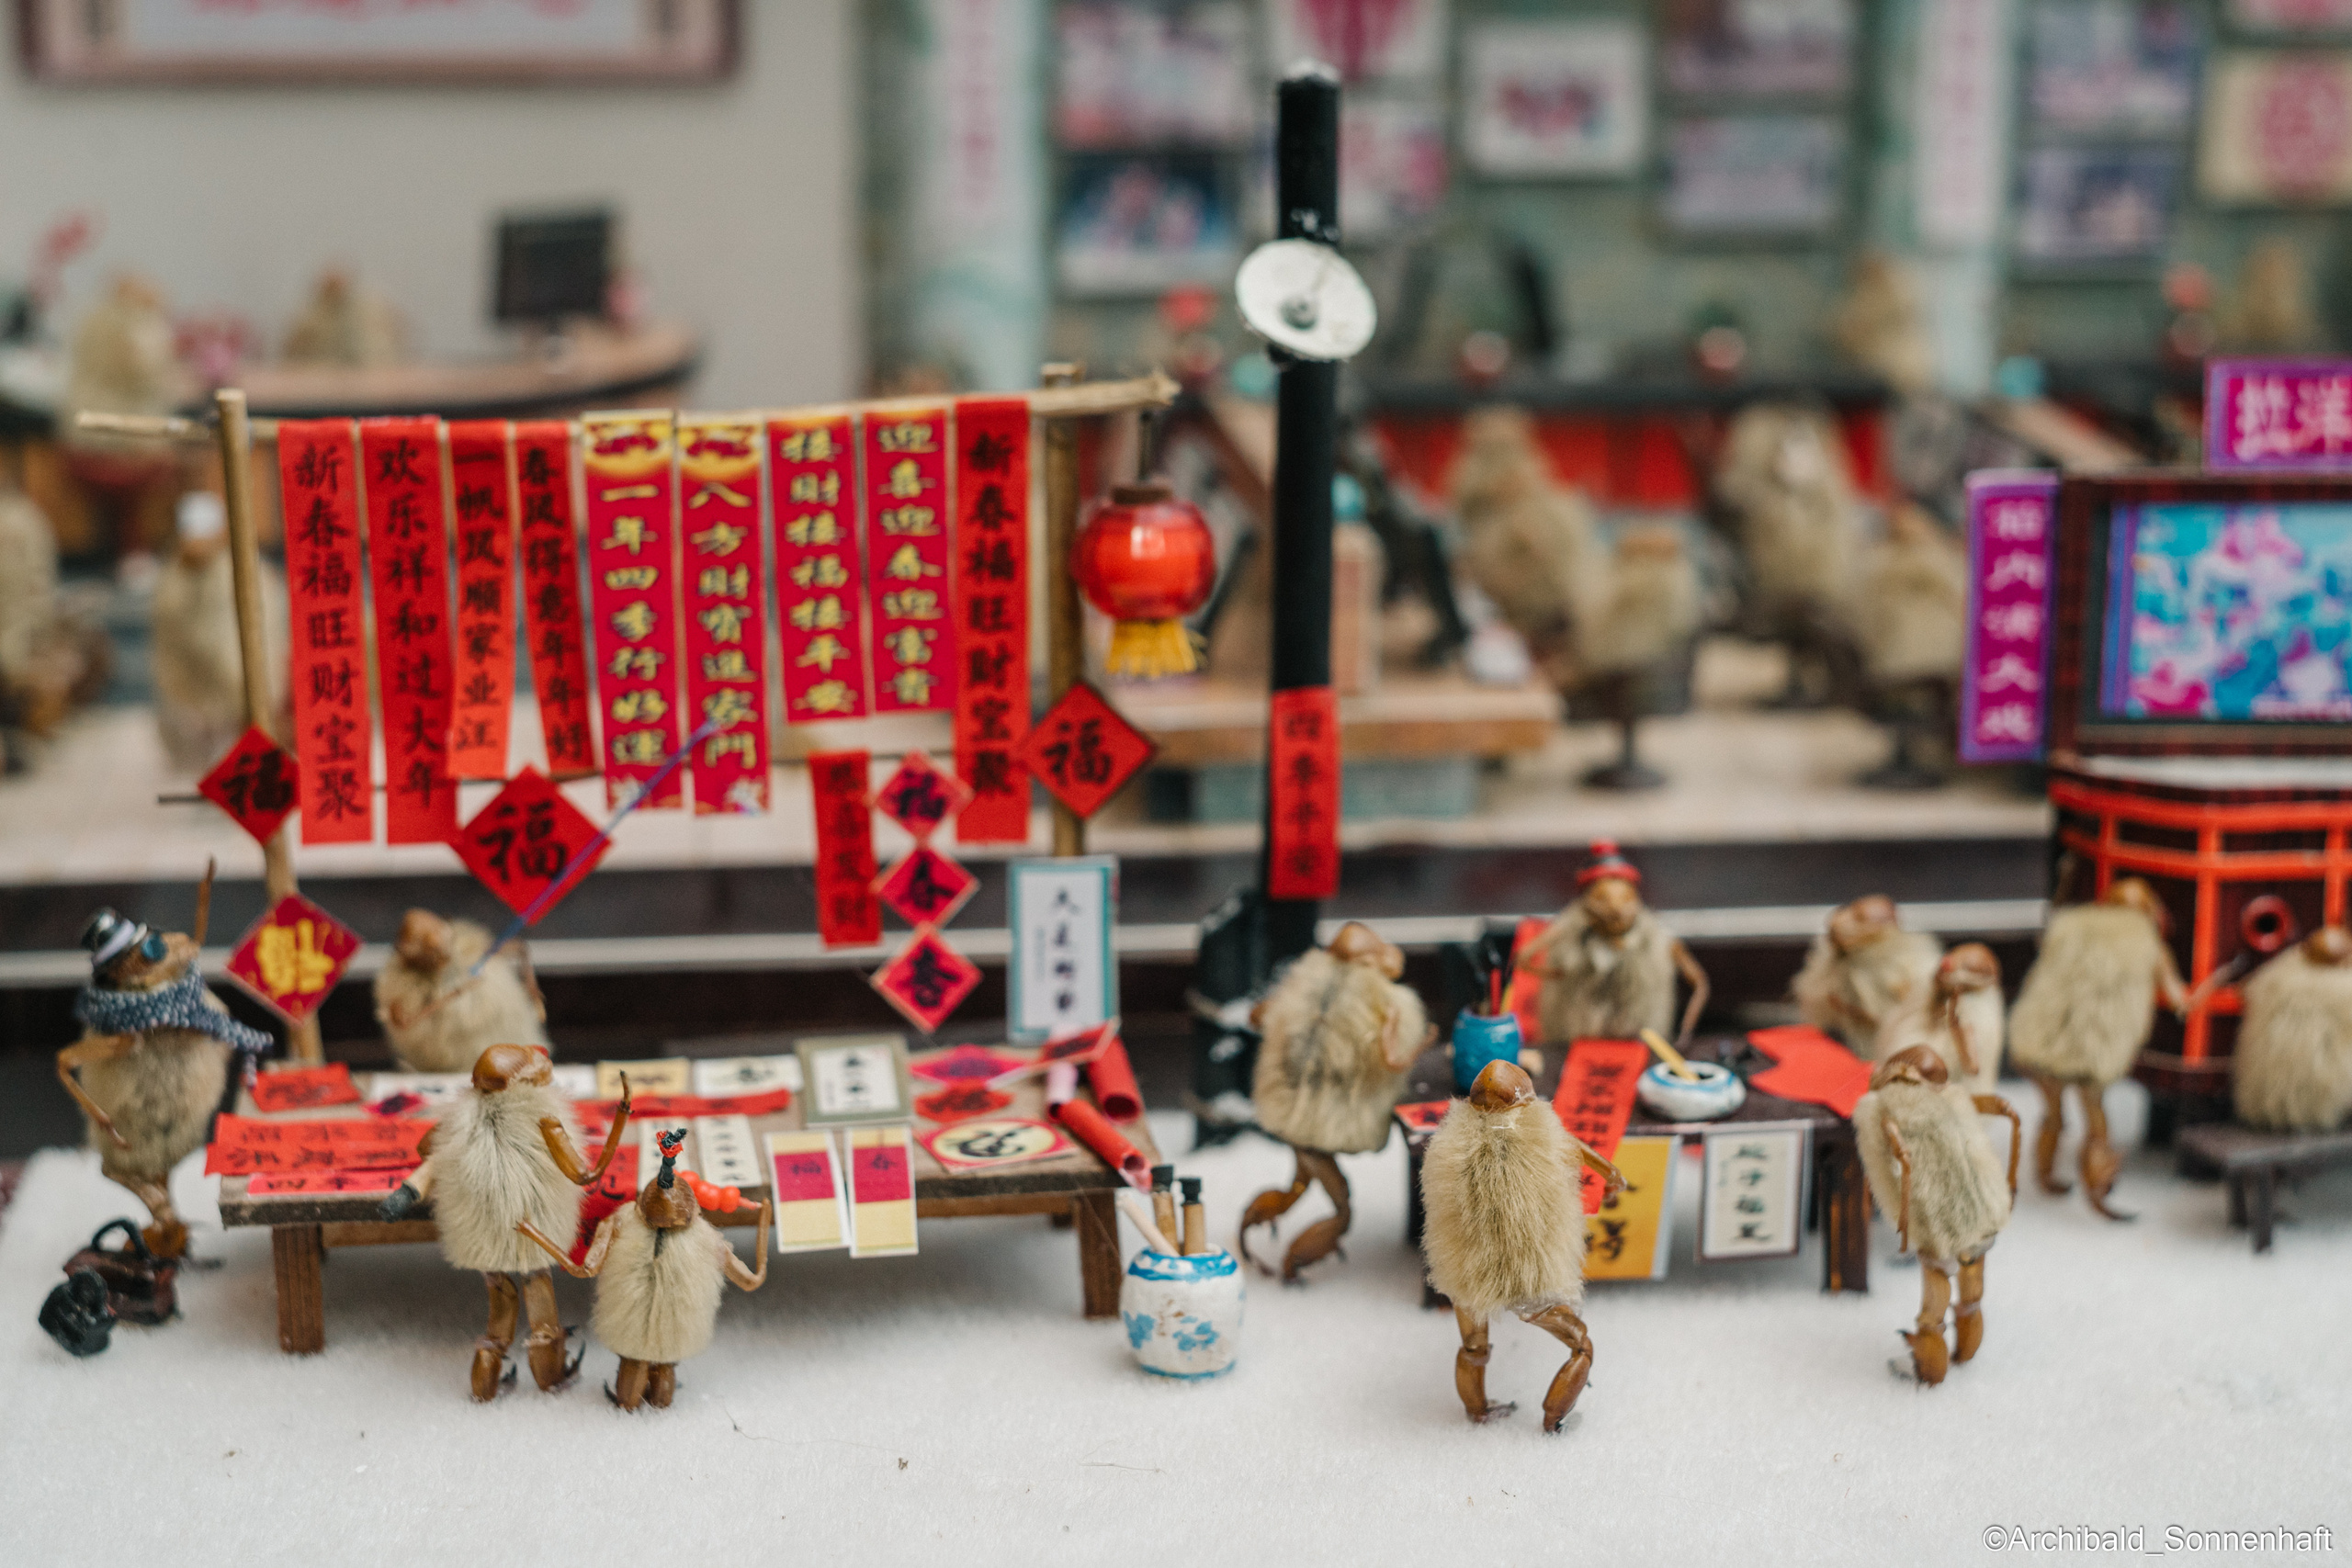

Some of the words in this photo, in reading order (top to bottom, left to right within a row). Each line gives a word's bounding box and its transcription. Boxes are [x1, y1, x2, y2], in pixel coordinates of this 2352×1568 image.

[293, 444, 366, 820] 新春福旺财宝聚
[376, 439, 448, 808] 欢乐祥和过大年
[221, 749, 294, 818] 福
[1042, 718, 1114, 786] 福
[479, 800, 568, 886] 福
